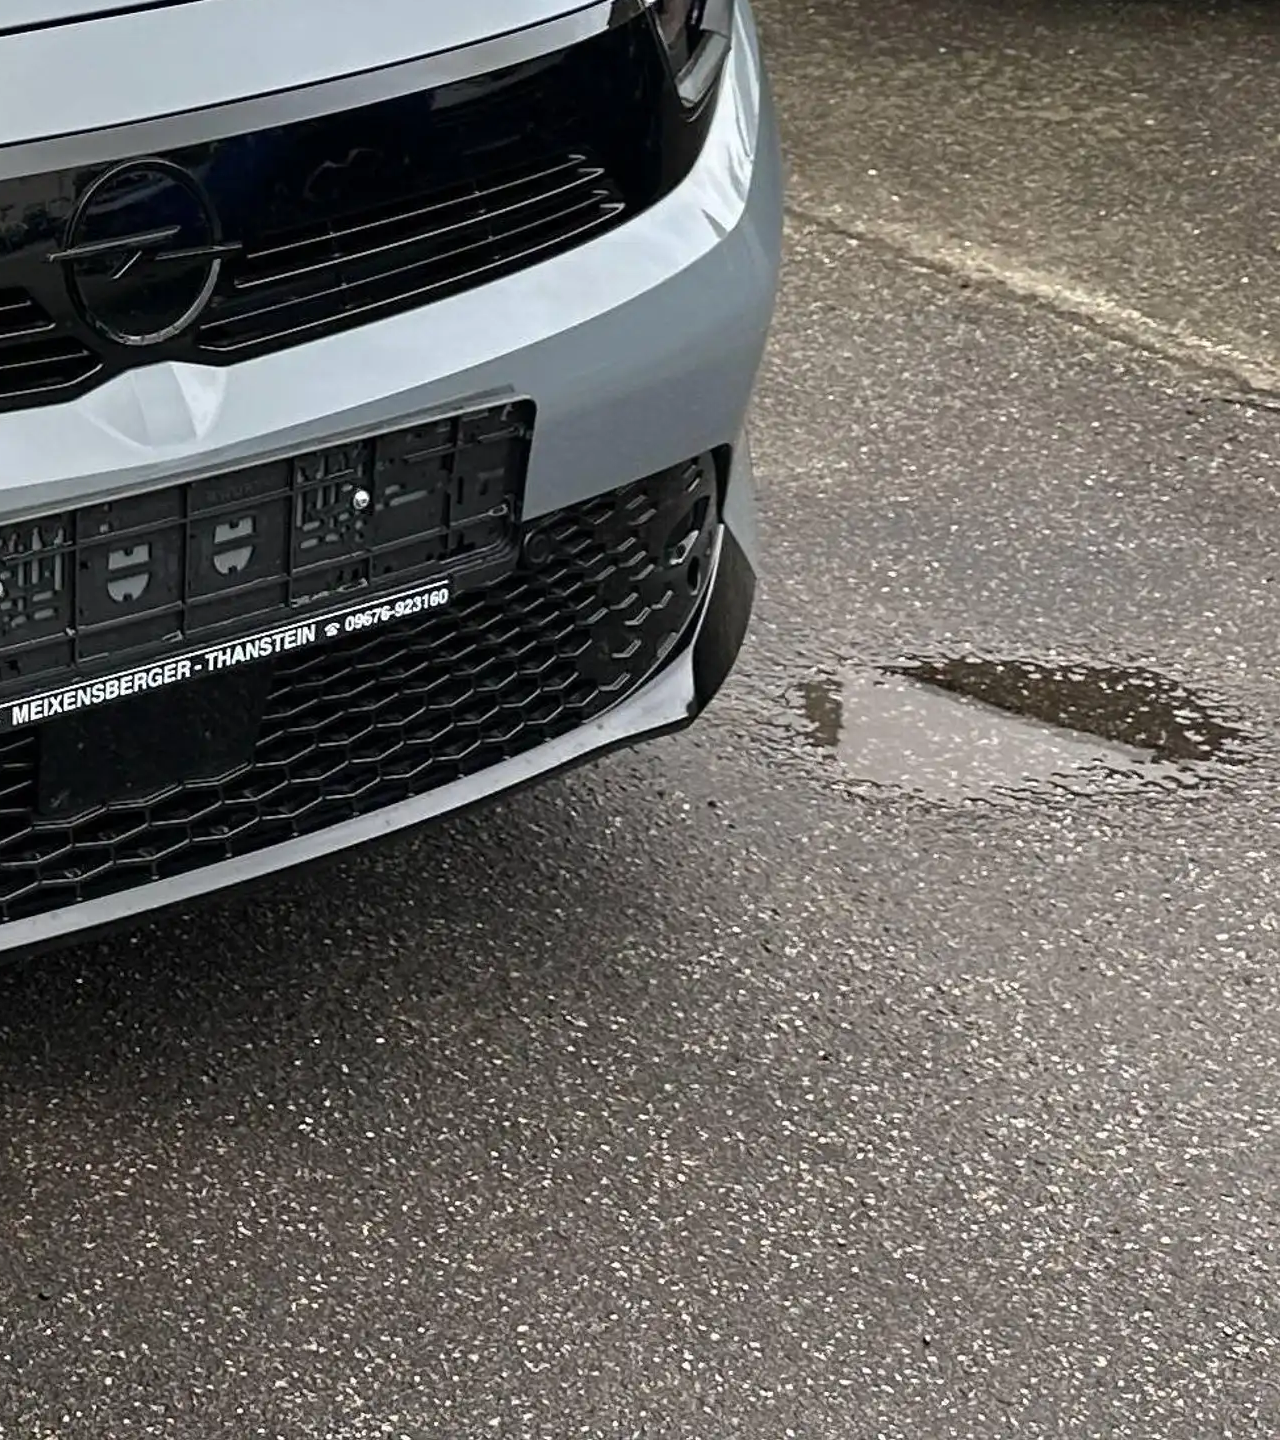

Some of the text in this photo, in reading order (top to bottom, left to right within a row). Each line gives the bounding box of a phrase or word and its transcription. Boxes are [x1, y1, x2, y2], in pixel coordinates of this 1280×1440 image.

[12, 660, 191, 725] MEIXENSBERGER
[205, 624, 316, 671] THANSTEIN
[345, 588, 449, 632] 09676-923160
